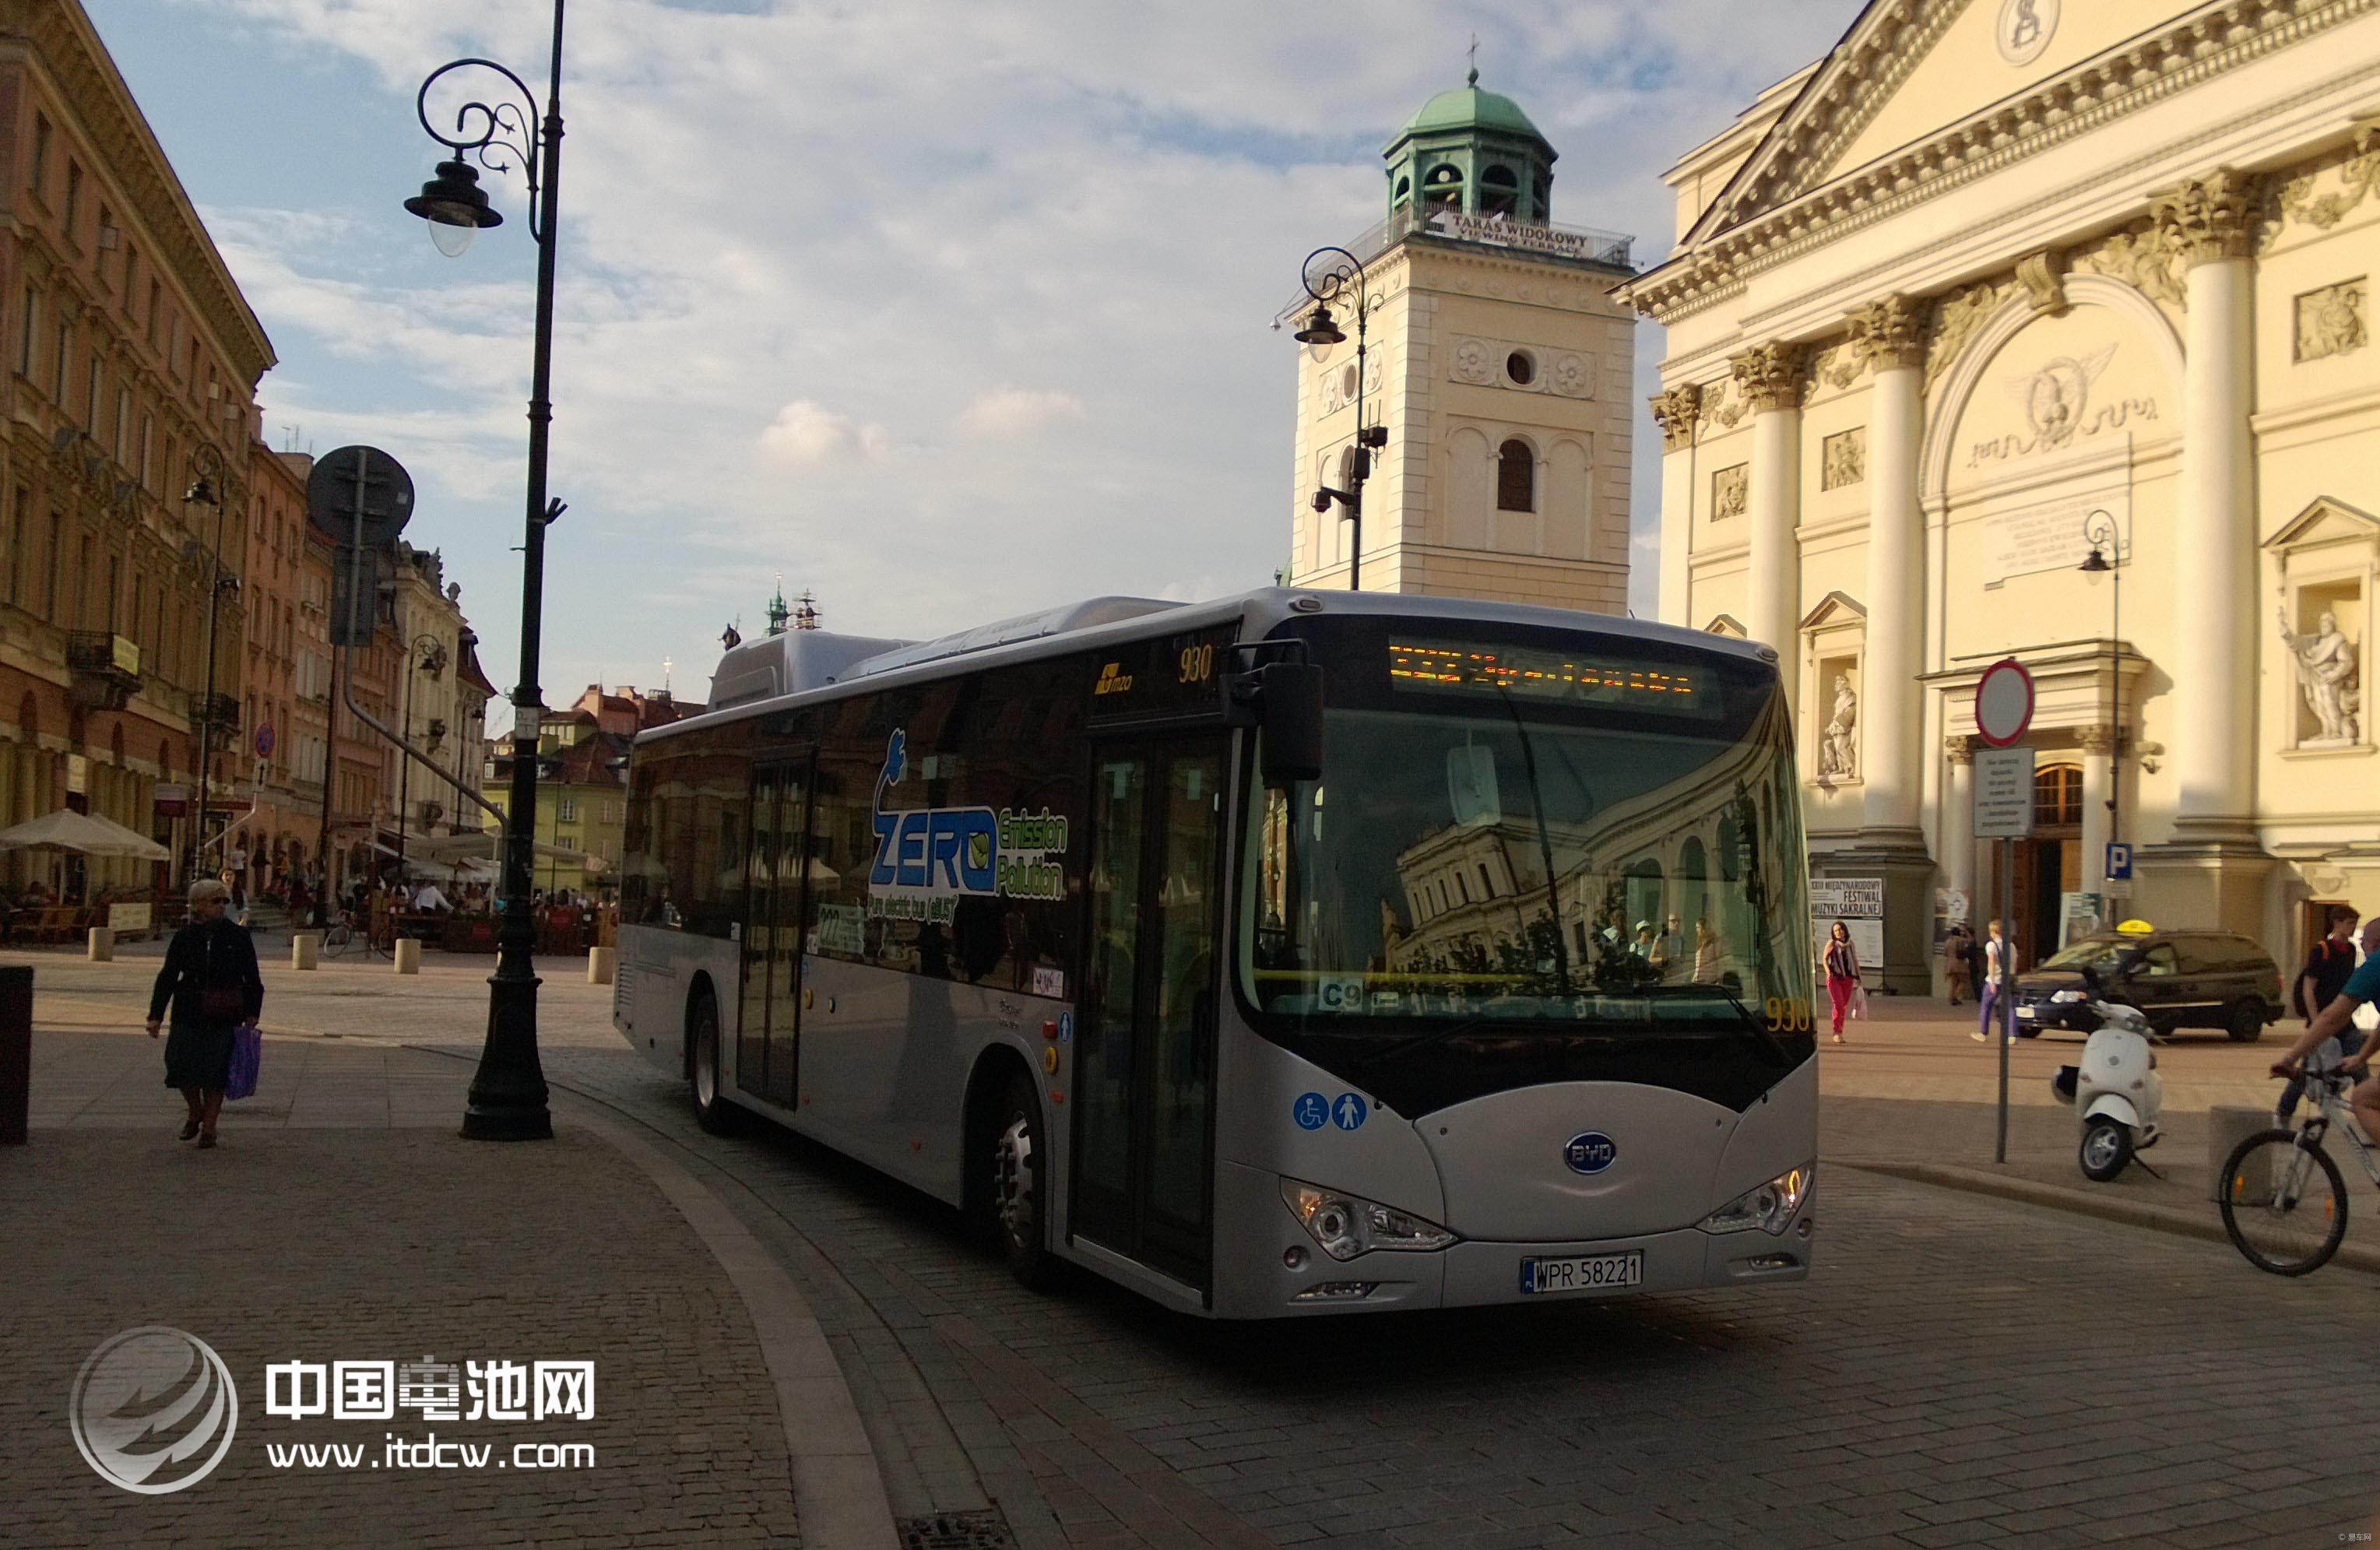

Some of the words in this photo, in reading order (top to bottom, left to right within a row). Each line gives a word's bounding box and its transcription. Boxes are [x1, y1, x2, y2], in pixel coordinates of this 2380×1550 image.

[1453, 215, 1503, 233] TARAS
[1506, 224, 1588, 248] WIDOKOWY
[1179, 643, 1212, 683] 930
[998, 810, 1067, 850] Emission
[870, 808, 997, 892] ZERO
[2110, 846, 2129, 875] P
[997, 855, 1063, 897] Pollution
[1811, 903, 1838, 916] MUZYKI
[1839, 903, 1882, 916] SAKRALNEJ
[1843, 891, 1882, 903] FESTIWAL
[1323, 982, 1362, 1007] C9
[1765, 997, 1809, 1032] 930
[1572, 1144, 1612, 1162] BYD
[1536, 1263, 1573, 1288] WPR
[1581, 1257, 1636, 1285] 58221
